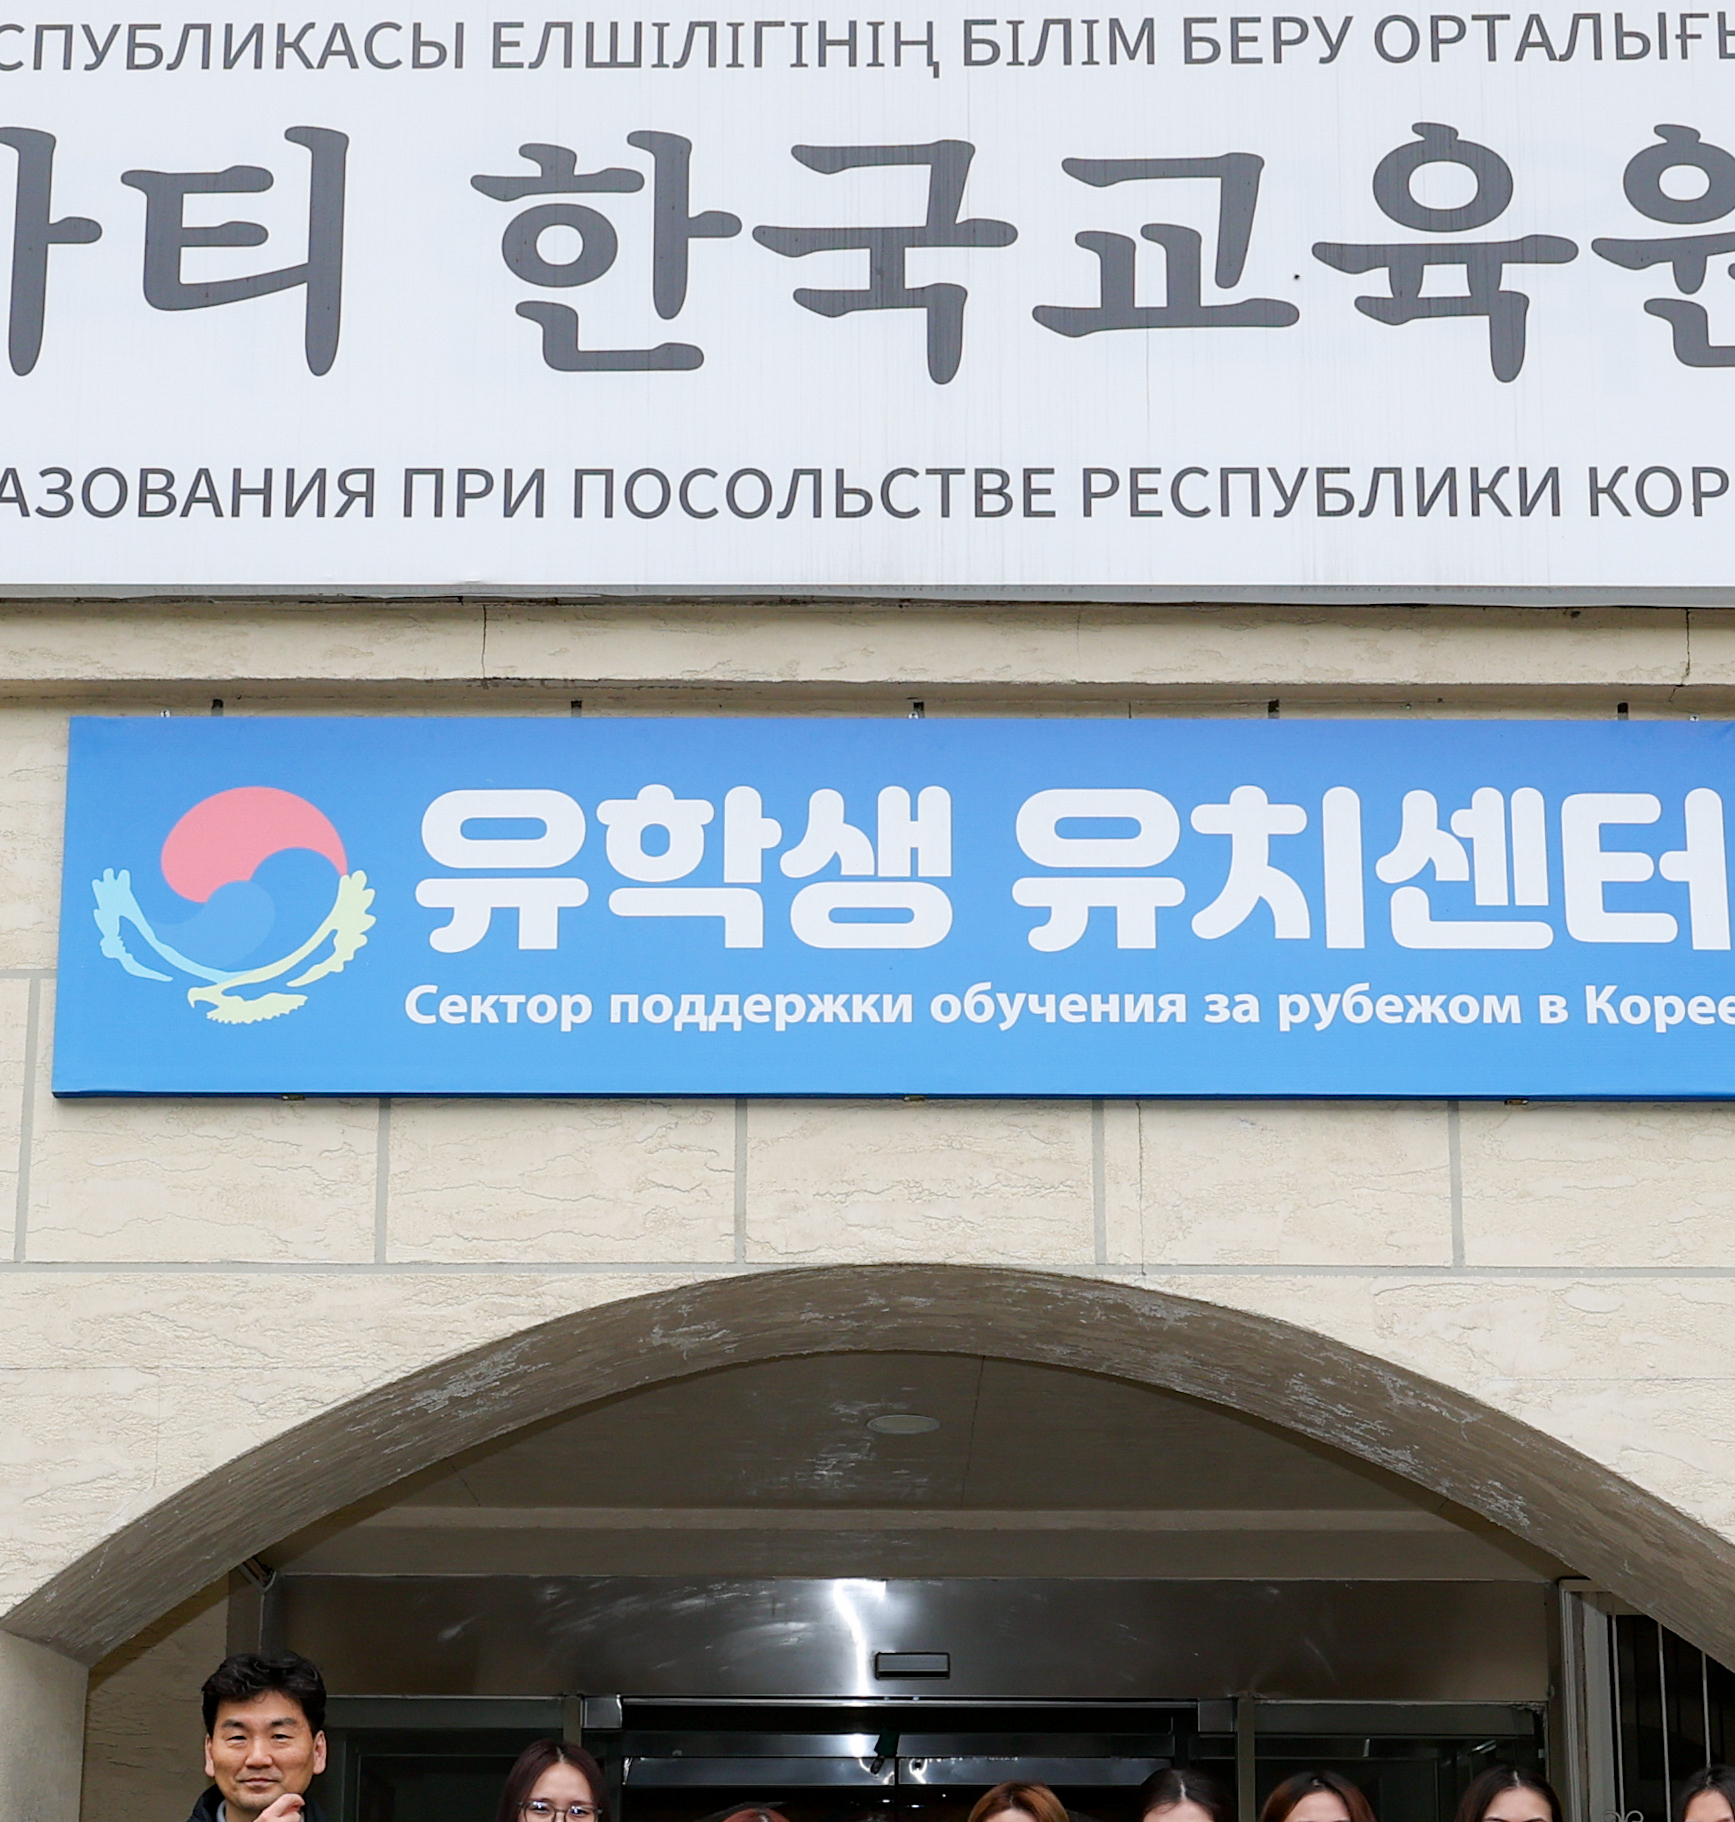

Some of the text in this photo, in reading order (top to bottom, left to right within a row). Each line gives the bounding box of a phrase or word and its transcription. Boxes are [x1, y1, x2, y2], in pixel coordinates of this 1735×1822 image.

[491, 20, 941, 79] ЕЛШІЛІГІНІҢ
[962, 17, 1156, 67] БІЛІМ
[1182, 15, 1355, 65] БЕРУ
[402, 467, 546, 519] ПРИ
[572, 466, 1057, 520] ПОСОЛЬСТВЕ
[1081, 465, 1562, 519] РЕСПУБЛИКИ
[414, 783, 1732, 954] 유학생 유치센터
[404, 983, 594, 1033] Сектор
[609, 992, 914, 1033] поддержки
[929, 980, 1188, 1032] обучения
[1203, 992, 1261, 1024] за
[1277, 981, 1523, 1033] рубежом
[1538, 993, 1570, 1025] в
